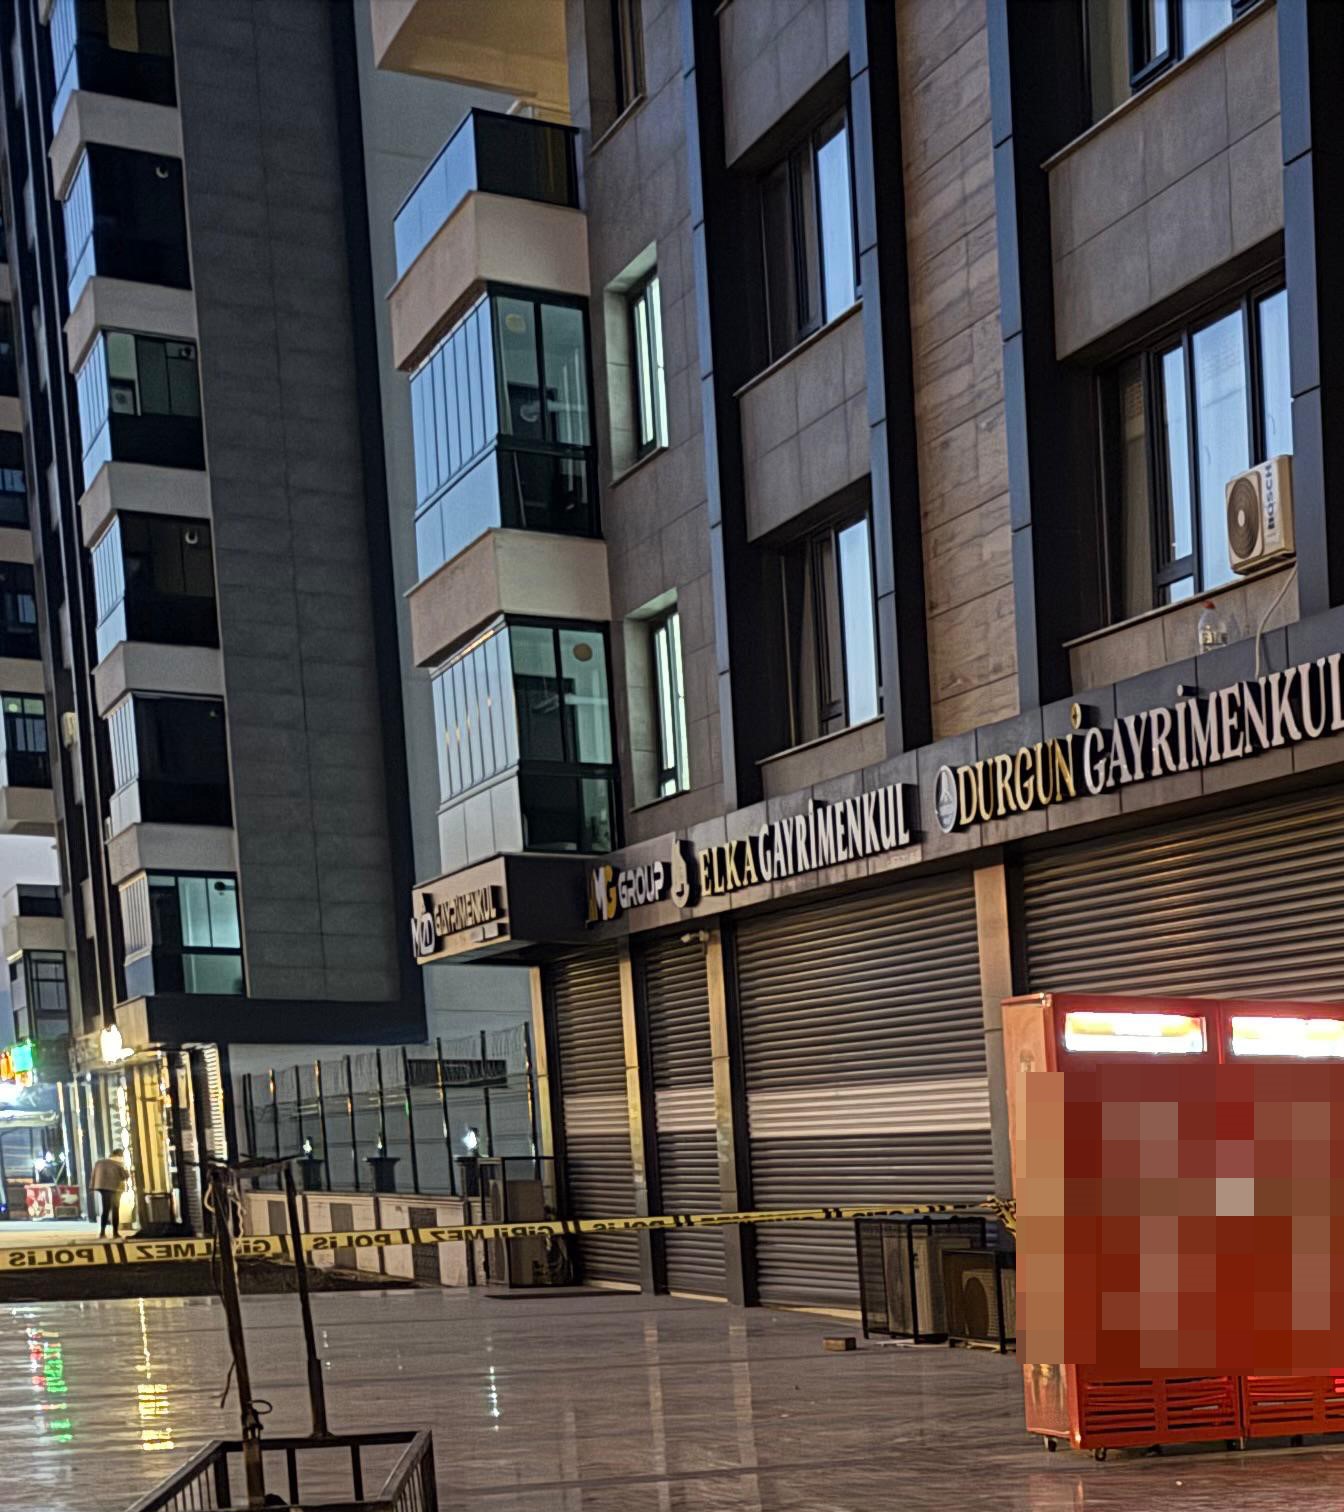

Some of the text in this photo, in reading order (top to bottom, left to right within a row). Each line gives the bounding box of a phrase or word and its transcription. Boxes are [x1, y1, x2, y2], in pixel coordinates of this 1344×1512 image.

[956, 733, 1077, 827] DURGUN
[618, 860, 665, 909] GROUP
[699, 782, 911, 898] ELKA GAYRİMENKUL
